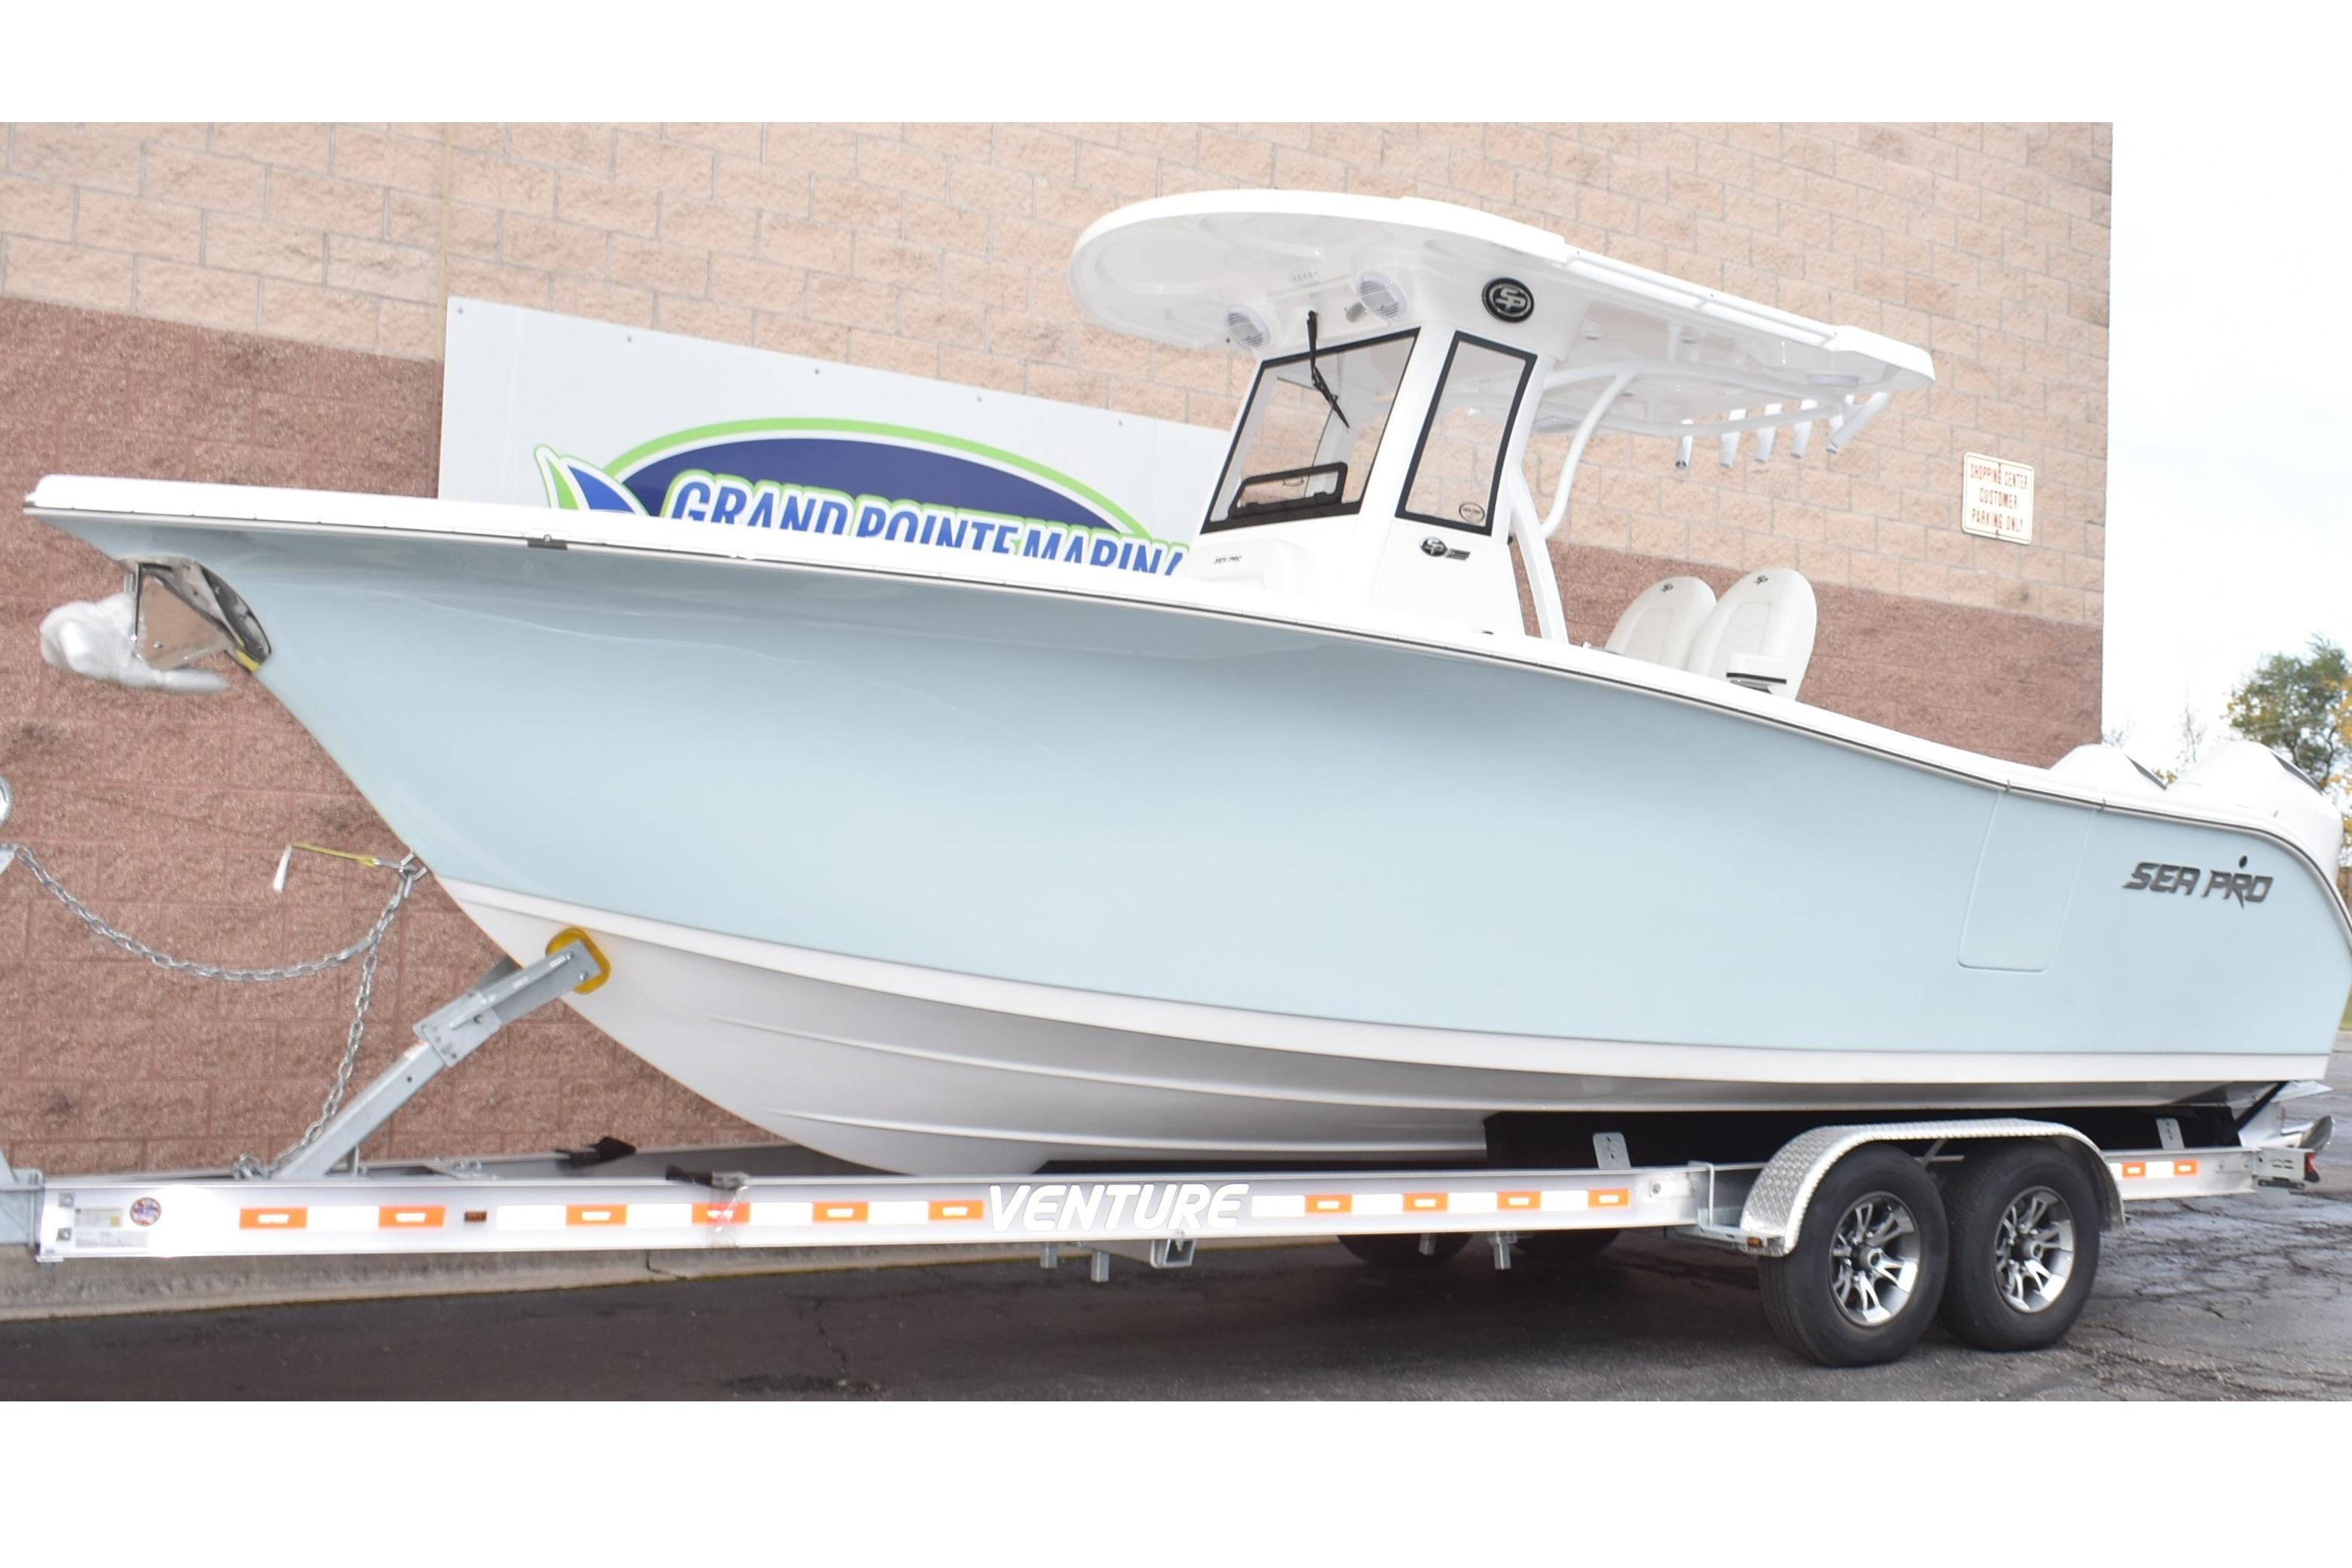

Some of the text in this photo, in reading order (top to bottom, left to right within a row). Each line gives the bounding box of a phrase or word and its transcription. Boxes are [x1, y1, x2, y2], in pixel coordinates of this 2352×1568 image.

[1970, 463, 2028, 490] SHOPPING CENTER
[1979, 487, 2018, 510] CUSTOMER
[1971, 507, 2023, 533] PARKING ONLY
[2122, 856, 2274, 909] SEA PRO
[989, 1184, 1249, 1232] VENTURE
